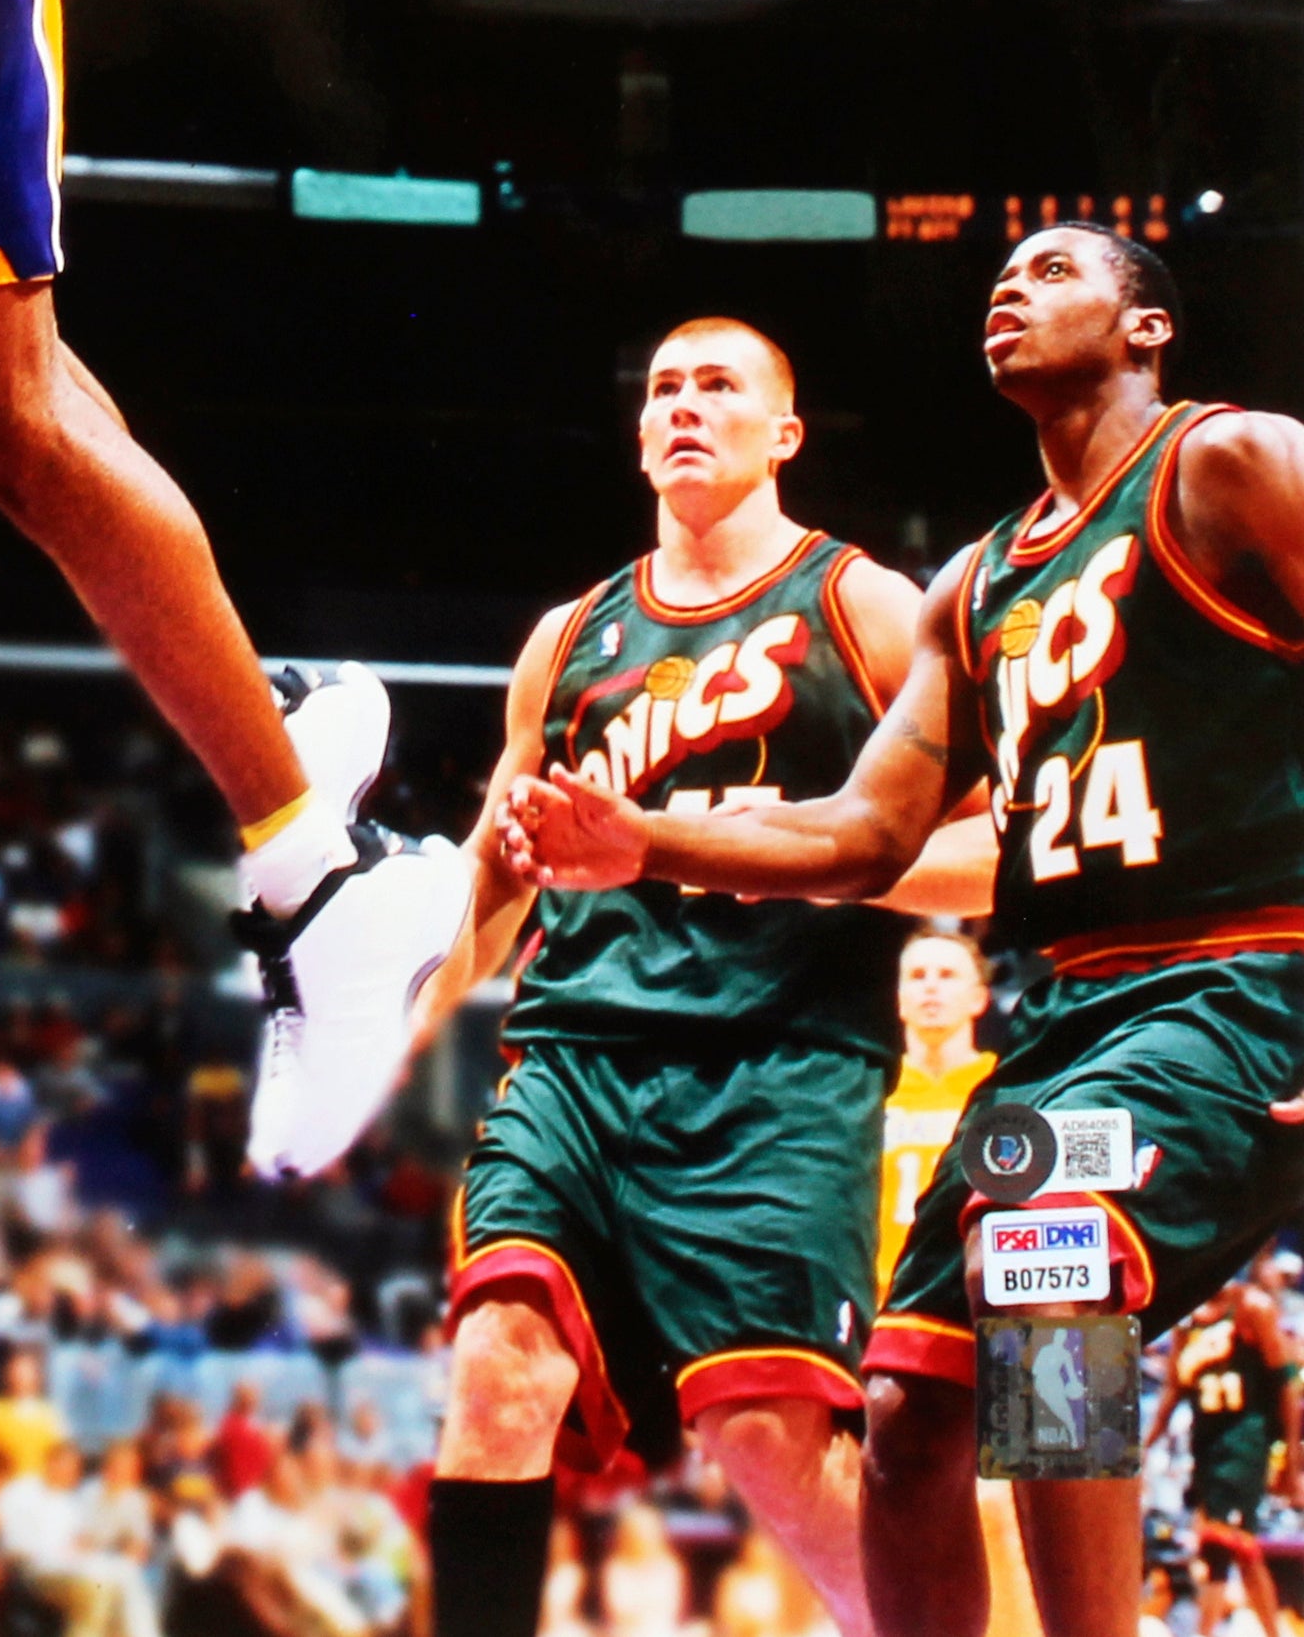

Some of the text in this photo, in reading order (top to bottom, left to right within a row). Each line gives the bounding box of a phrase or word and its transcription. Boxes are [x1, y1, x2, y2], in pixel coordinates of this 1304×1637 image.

[1029, 739, 1163, 883] 24
[996, 1224, 1094, 1251] PSA DNA
[1004, 1265, 1090, 1291] B07573
